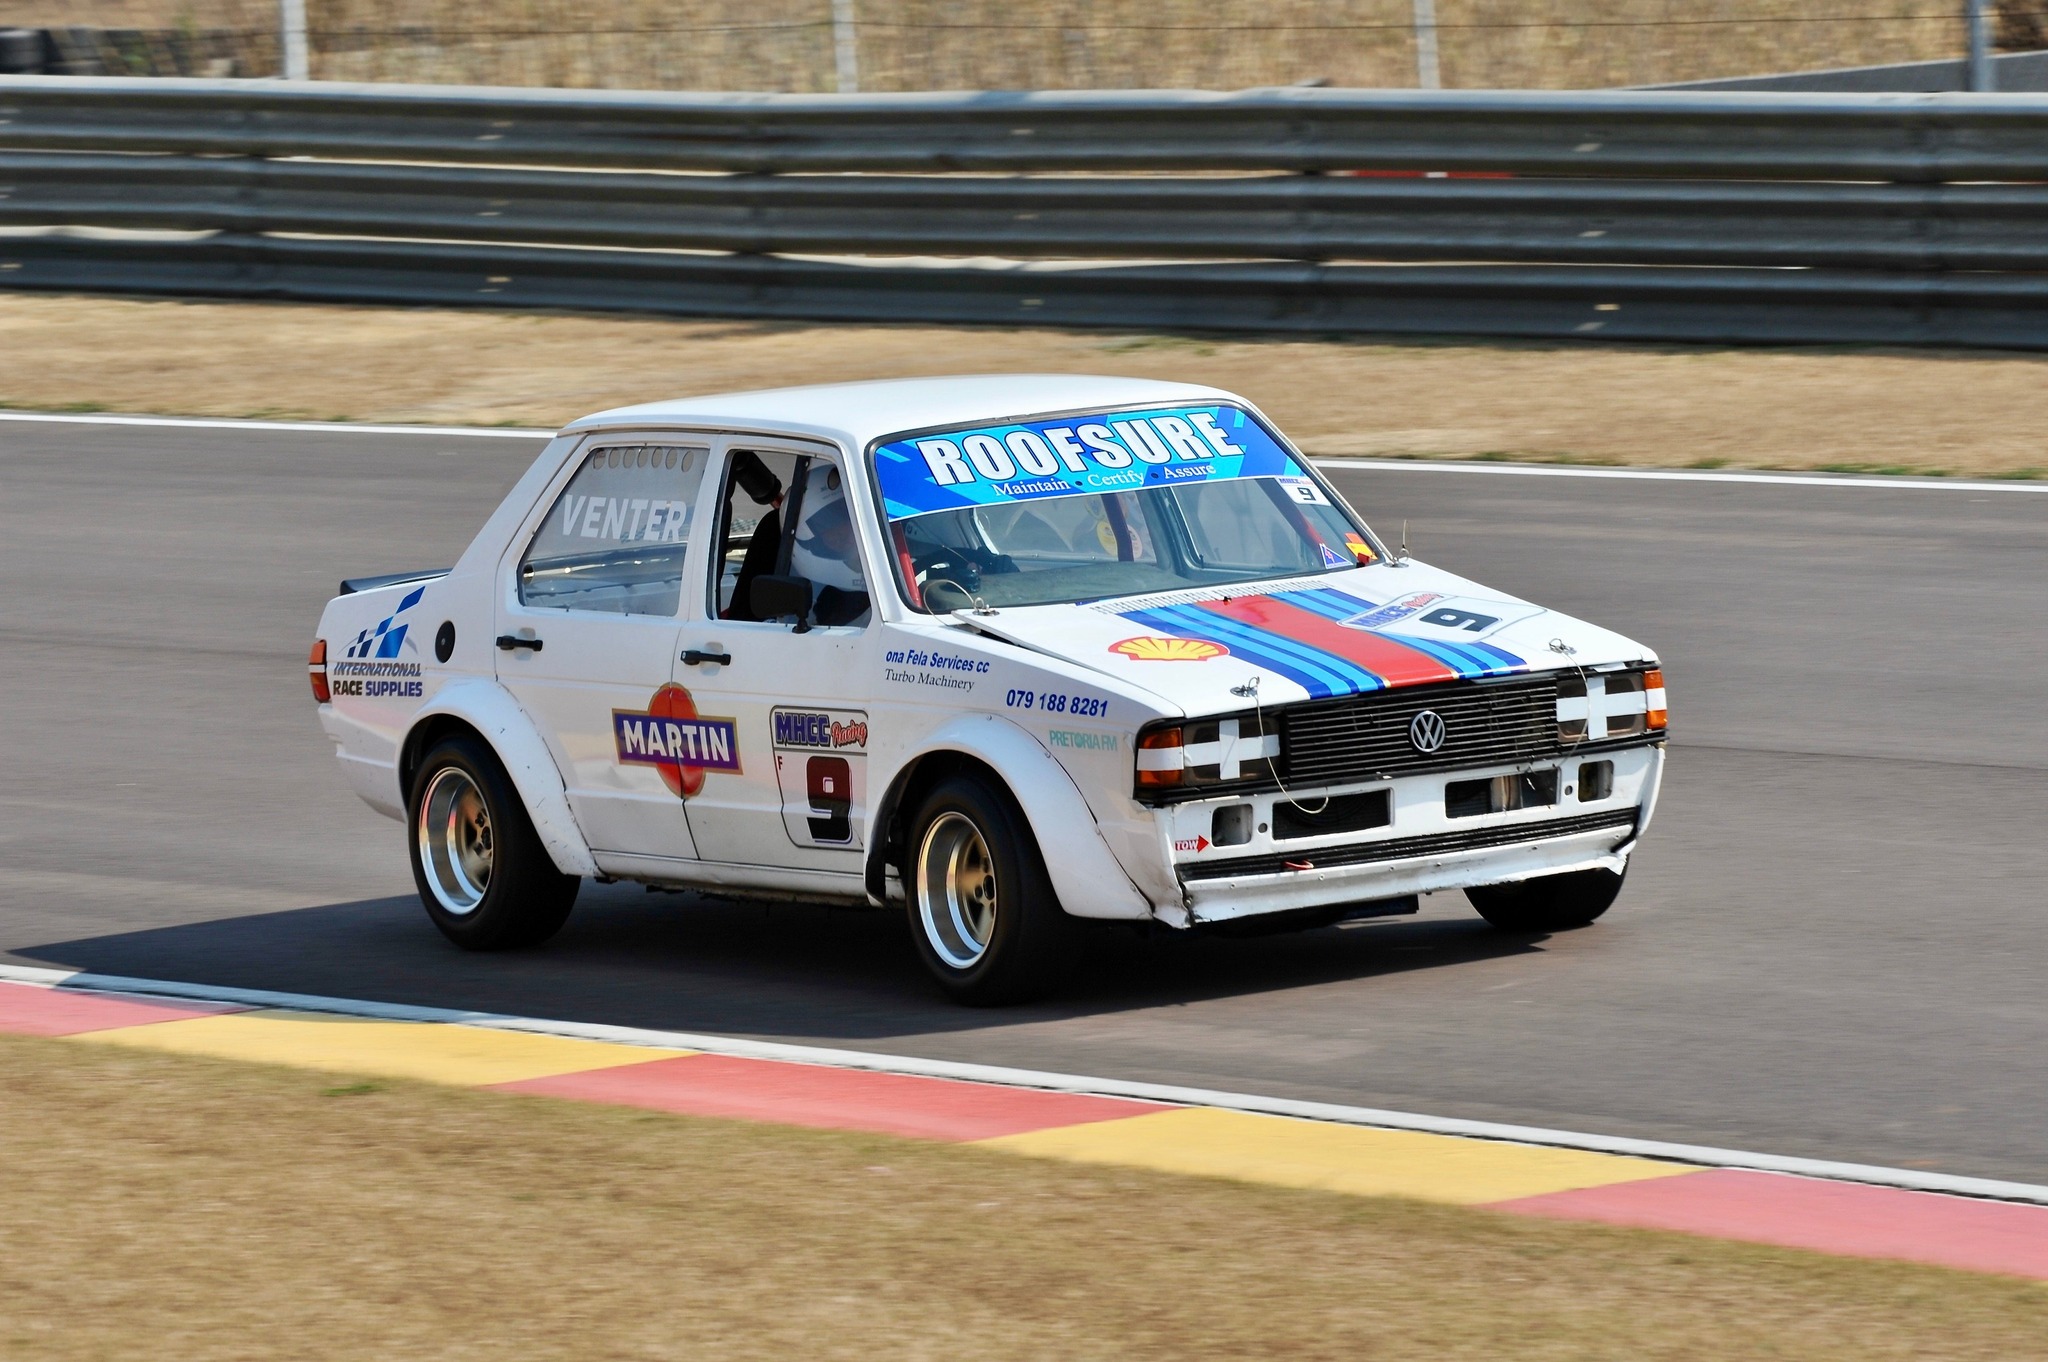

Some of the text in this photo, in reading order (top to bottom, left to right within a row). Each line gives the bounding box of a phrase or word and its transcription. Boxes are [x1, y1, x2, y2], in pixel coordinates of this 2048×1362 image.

[916, 412, 1246, 486] ROOFSURE
[992, 464, 1217, 497] Maintain Certify Assure
[1297, 486, 1317, 501] 9
[562, 493, 687, 542] VENTER
[1418, 608, 1503, 632] 9
[333, 661, 422, 677] INTERNATIONAL
[885, 649, 990, 674] ona Fela Services cc
[333, 680, 423, 697] RACE SUPPLIES
[885, 668, 975, 693] Turbo Machinery
[1006, 689, 1108, 718] 079 188 8281
[622, 719, 731, 763] MARTIN
[774, 711, 868, 749] MHCC Racing
[1049, 730, 1118, 752] PRETORIA FM
[777, 755, 784, 770] F
[806, 755, 854, 845] 9
[1175, 839, 1198, 851] TOW
